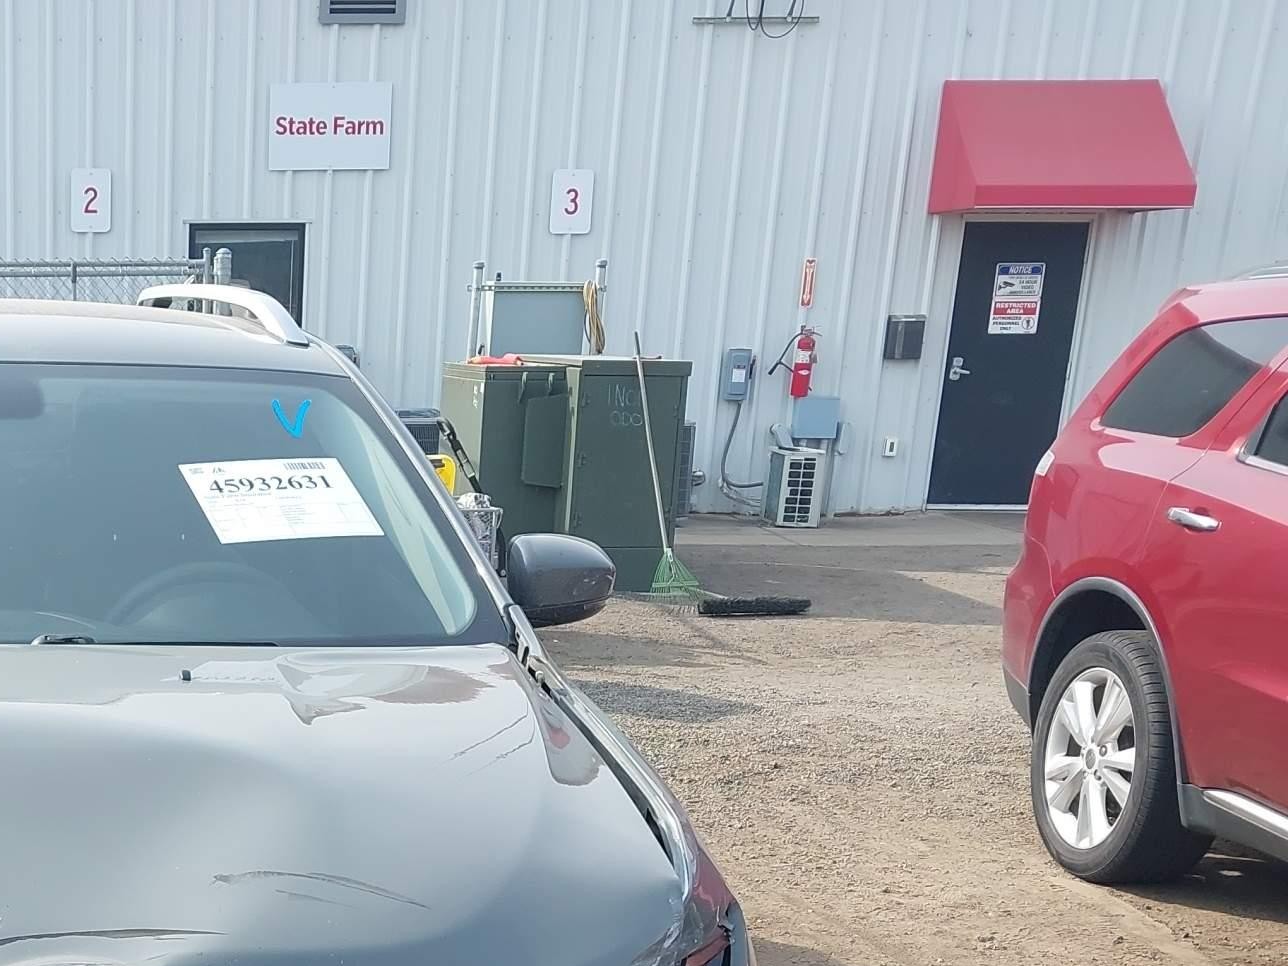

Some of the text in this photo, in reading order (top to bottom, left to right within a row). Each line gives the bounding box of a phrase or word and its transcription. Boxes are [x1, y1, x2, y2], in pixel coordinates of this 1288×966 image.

[275, 116, 385, 136] State Farm
[83, 187, 98, 214] 2
[564, 188, 579, 215] 3
[1008, 265, 1032, 274] NOTICE
[209, 475, 334, 493] 45932631
